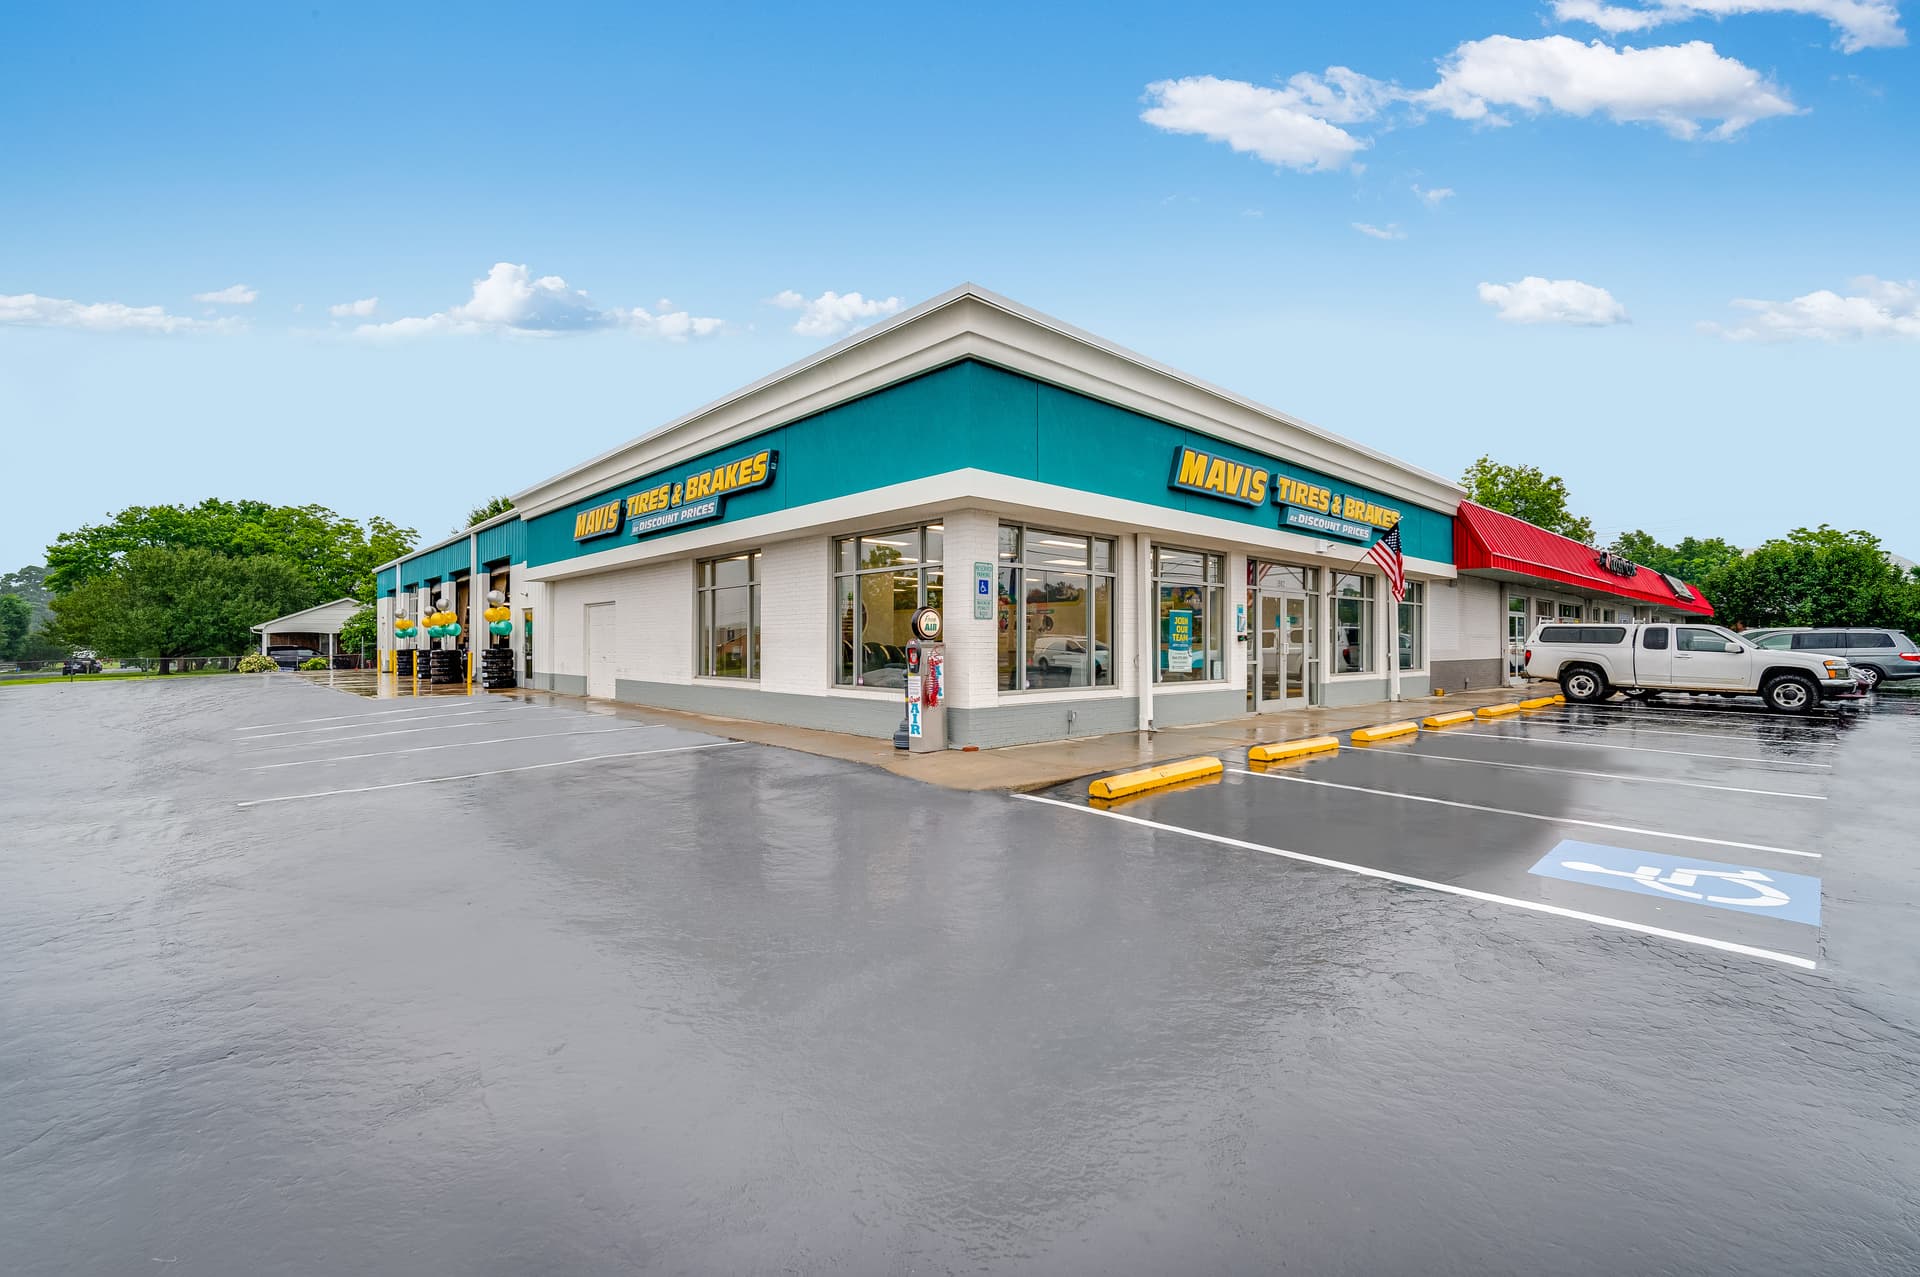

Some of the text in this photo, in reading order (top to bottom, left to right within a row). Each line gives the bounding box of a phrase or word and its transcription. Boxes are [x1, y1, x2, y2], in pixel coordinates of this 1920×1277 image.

[575, 452, 768, 538] MAVIS TIRES & BRAKES
[1179, 450, 1400, 528] MAVIS TIRES & BRAKES
[639, 511, 679, 530] DISCOUNT
[680, 502, 715, 520] PRICES
[1298, 514, 1341, 531] DISCOUNT
[1342, 526, 1370, 538] PRICES
[1172, 633, 1188, 642] TEAM
[1176, 625, 1188, 633] OUR
[910, 703, 920, 734] AIR
